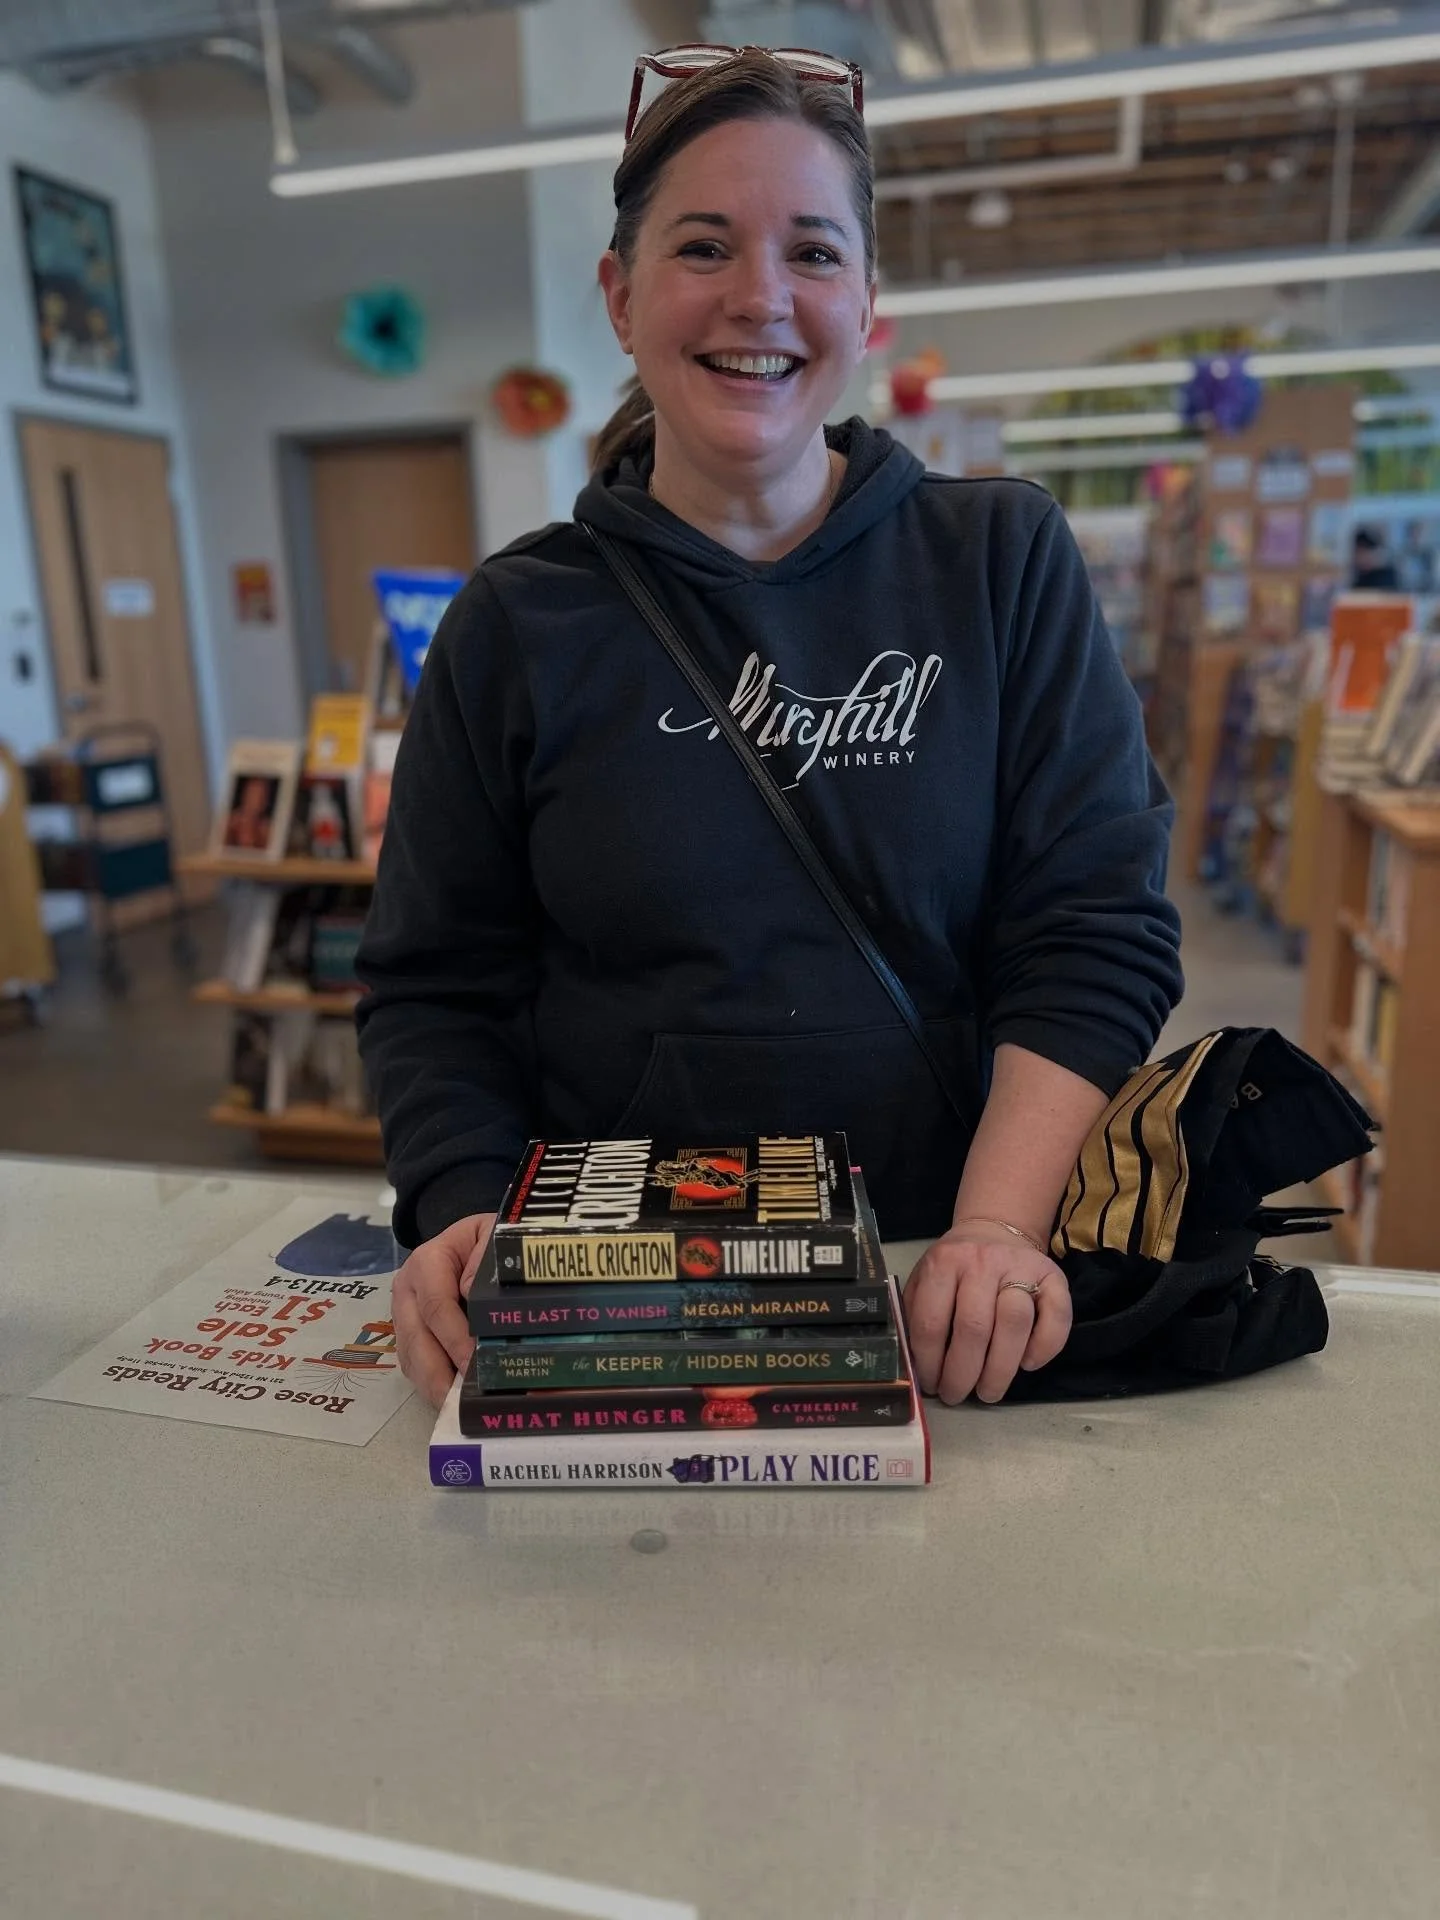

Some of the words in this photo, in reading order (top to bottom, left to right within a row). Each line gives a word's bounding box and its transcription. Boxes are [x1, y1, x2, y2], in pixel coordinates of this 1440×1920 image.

[823, 751, 916, 770] WINERY
[519, 1141, 588, 1227] MICHAEL
[567, 1139, 653, 1226] CRICHTON
[757, 1136, 820, 1223] TIMELINE
[527, 1243, 593, 1278] MICHAEL
[597, 1241, 673, 1276] CRICHTON
[721, 1240, 811, 1274] TIMELINE
[223, 1288, 248, 1297] Adult
[224, 1294, 271, 1306] Including
[249, 1291, 286, 1301] Young
[214, 1301, 270, 1316] Each
[272, 1296, 337, 1324] $1
[489, 1311, 522, 1324] THE
[528, 1308, 571, 1323] LAST
[576, 1307, 600, 1320] TO
[605, 1305, 668, 1319] VANISH
[683, 1303, 744, 1317] MEGAN
[751, 1301, 831, 1314] MIRANDA
[196, 1318, 298, 1347] Sale
[144, 1338, 223, 1361] Book
[228, 1349, 297, 1370] Kids
[499, 1356, 555, 1367] MADELINE
[505, 1368, 549, 1377] MARTIN
[572, 1359, 590, 1371] the
[595, 1356, 665, 1372] KEEPER
[669, 1354, 683, 1373] of
[687, 1355, 758, 1369] HIDDEN
[765, 1353, 832, 1368] BOOKS
[102, 1365, 198, 1392] Reads
[198, 1376, 268, 1401] City
[275, 1389, 356, 1414] Rose
[772, 1402, 859, 1413] CATHERINE
[481, 1412, 563, 1430] WHAT
[573, 1409, 686, 1427] HUNGER
[795, 1414, 837, 1423] DANG
[489, 1463, 561, 1480] RACHEL
[567, 1462, 663, 1479] HARRISON
[721, 1454, 799, 1482] PLAY
[810, 1454, 880, 1482] NICE
